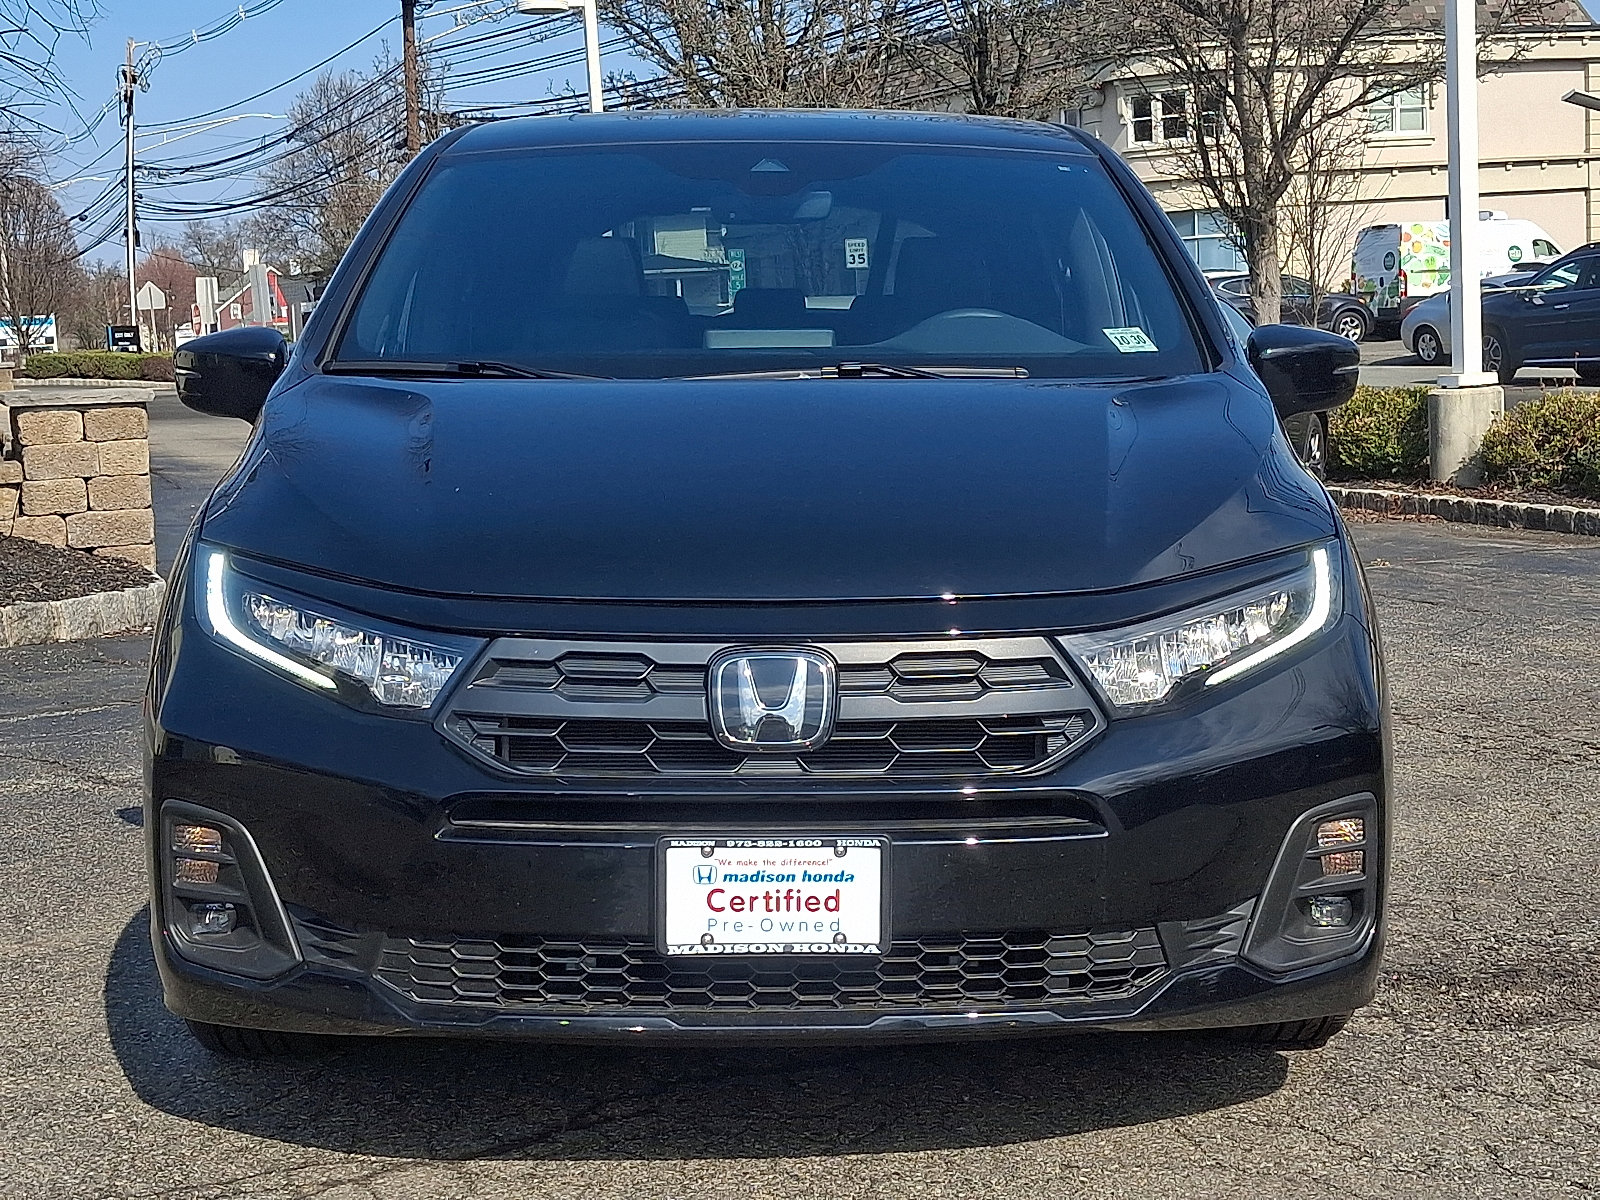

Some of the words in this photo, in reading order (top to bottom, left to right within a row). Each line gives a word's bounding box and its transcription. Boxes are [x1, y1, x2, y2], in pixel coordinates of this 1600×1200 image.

[849, 253, 866, 265] 35
[723, 870, 796, 882] madison
[802, 870, 854, 882] honda
[706, 888, 840, 912] Certified
[708, 917, 840, 932] Pre-Owned
[667, 944, 784, 955] MADISON
[791, 944, 882, 954] HONDA
